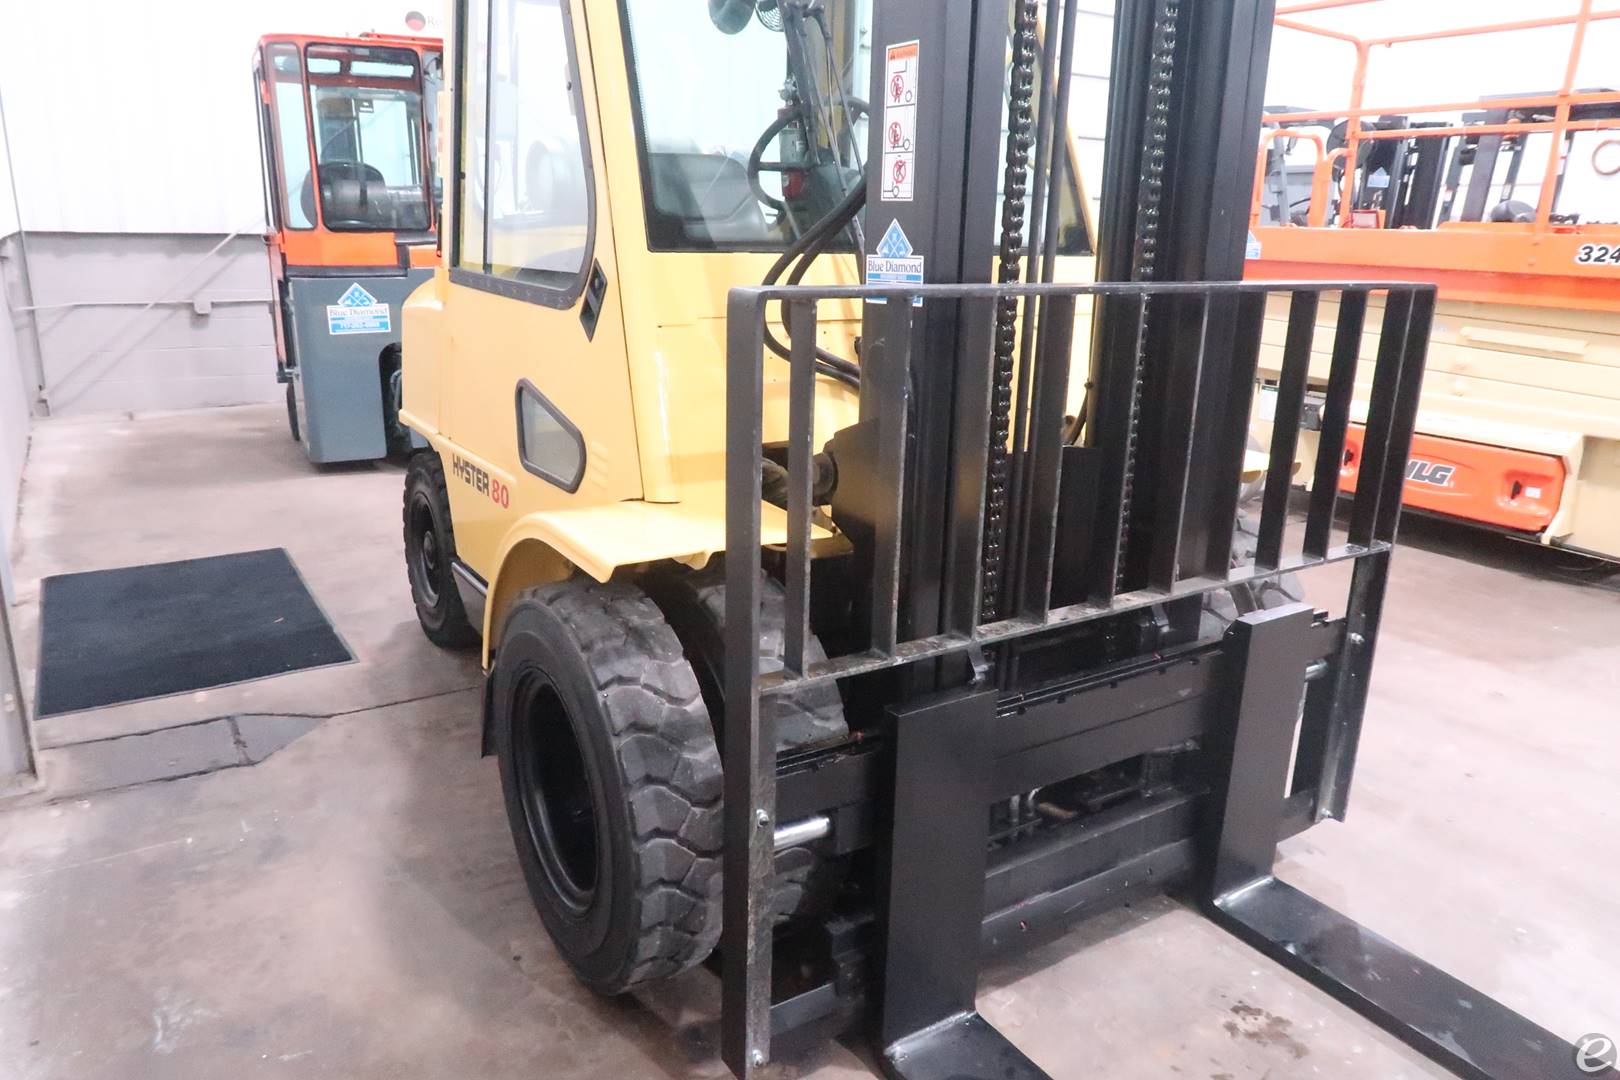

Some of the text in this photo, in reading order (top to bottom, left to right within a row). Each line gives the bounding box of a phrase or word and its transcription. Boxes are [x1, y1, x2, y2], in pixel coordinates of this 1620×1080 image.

[868, 260, 922, 273] Blue Diamond
[452, 453, 509, 509] HYSTER 80
